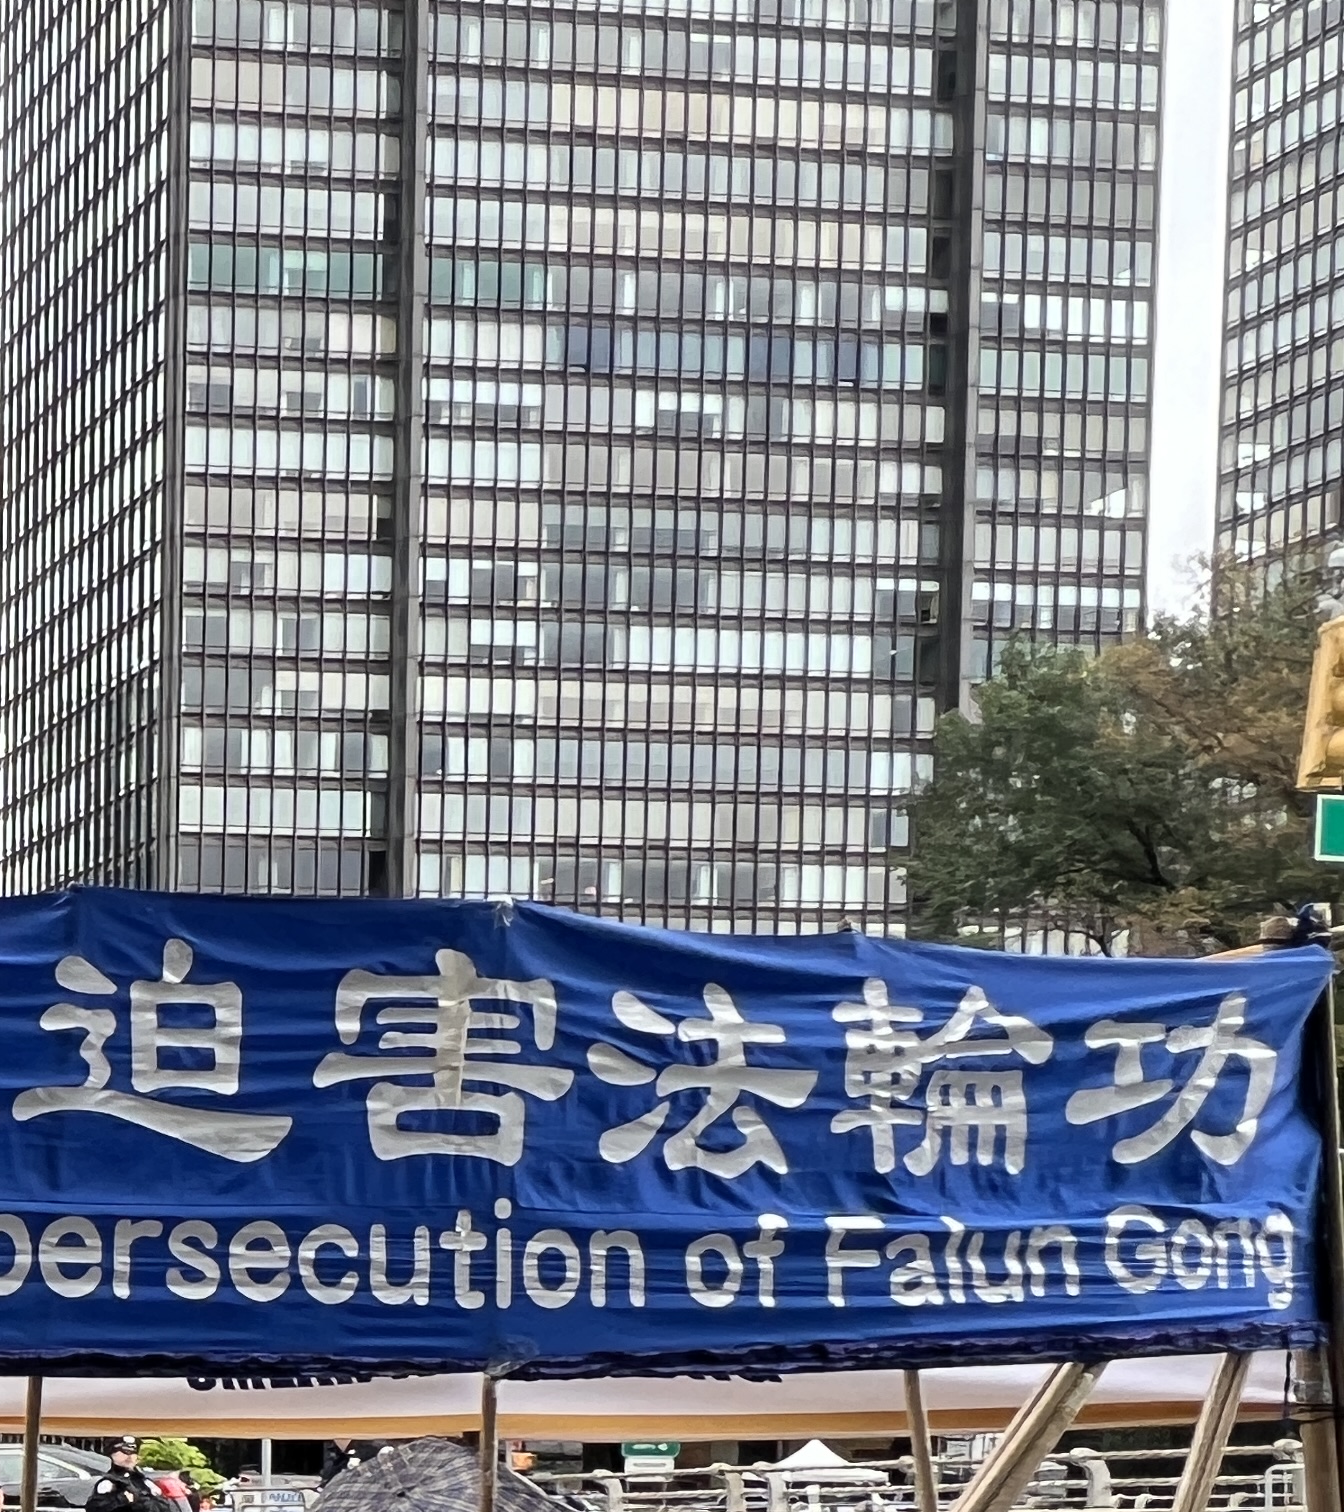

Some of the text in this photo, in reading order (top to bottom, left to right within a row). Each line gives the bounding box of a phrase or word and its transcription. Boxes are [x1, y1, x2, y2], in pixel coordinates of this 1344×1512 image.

[685, 1213, 788, 1308] of
[824, 1214, 1081, 1307] Falun
[1104, 1205, 1294, 1310] Gong
